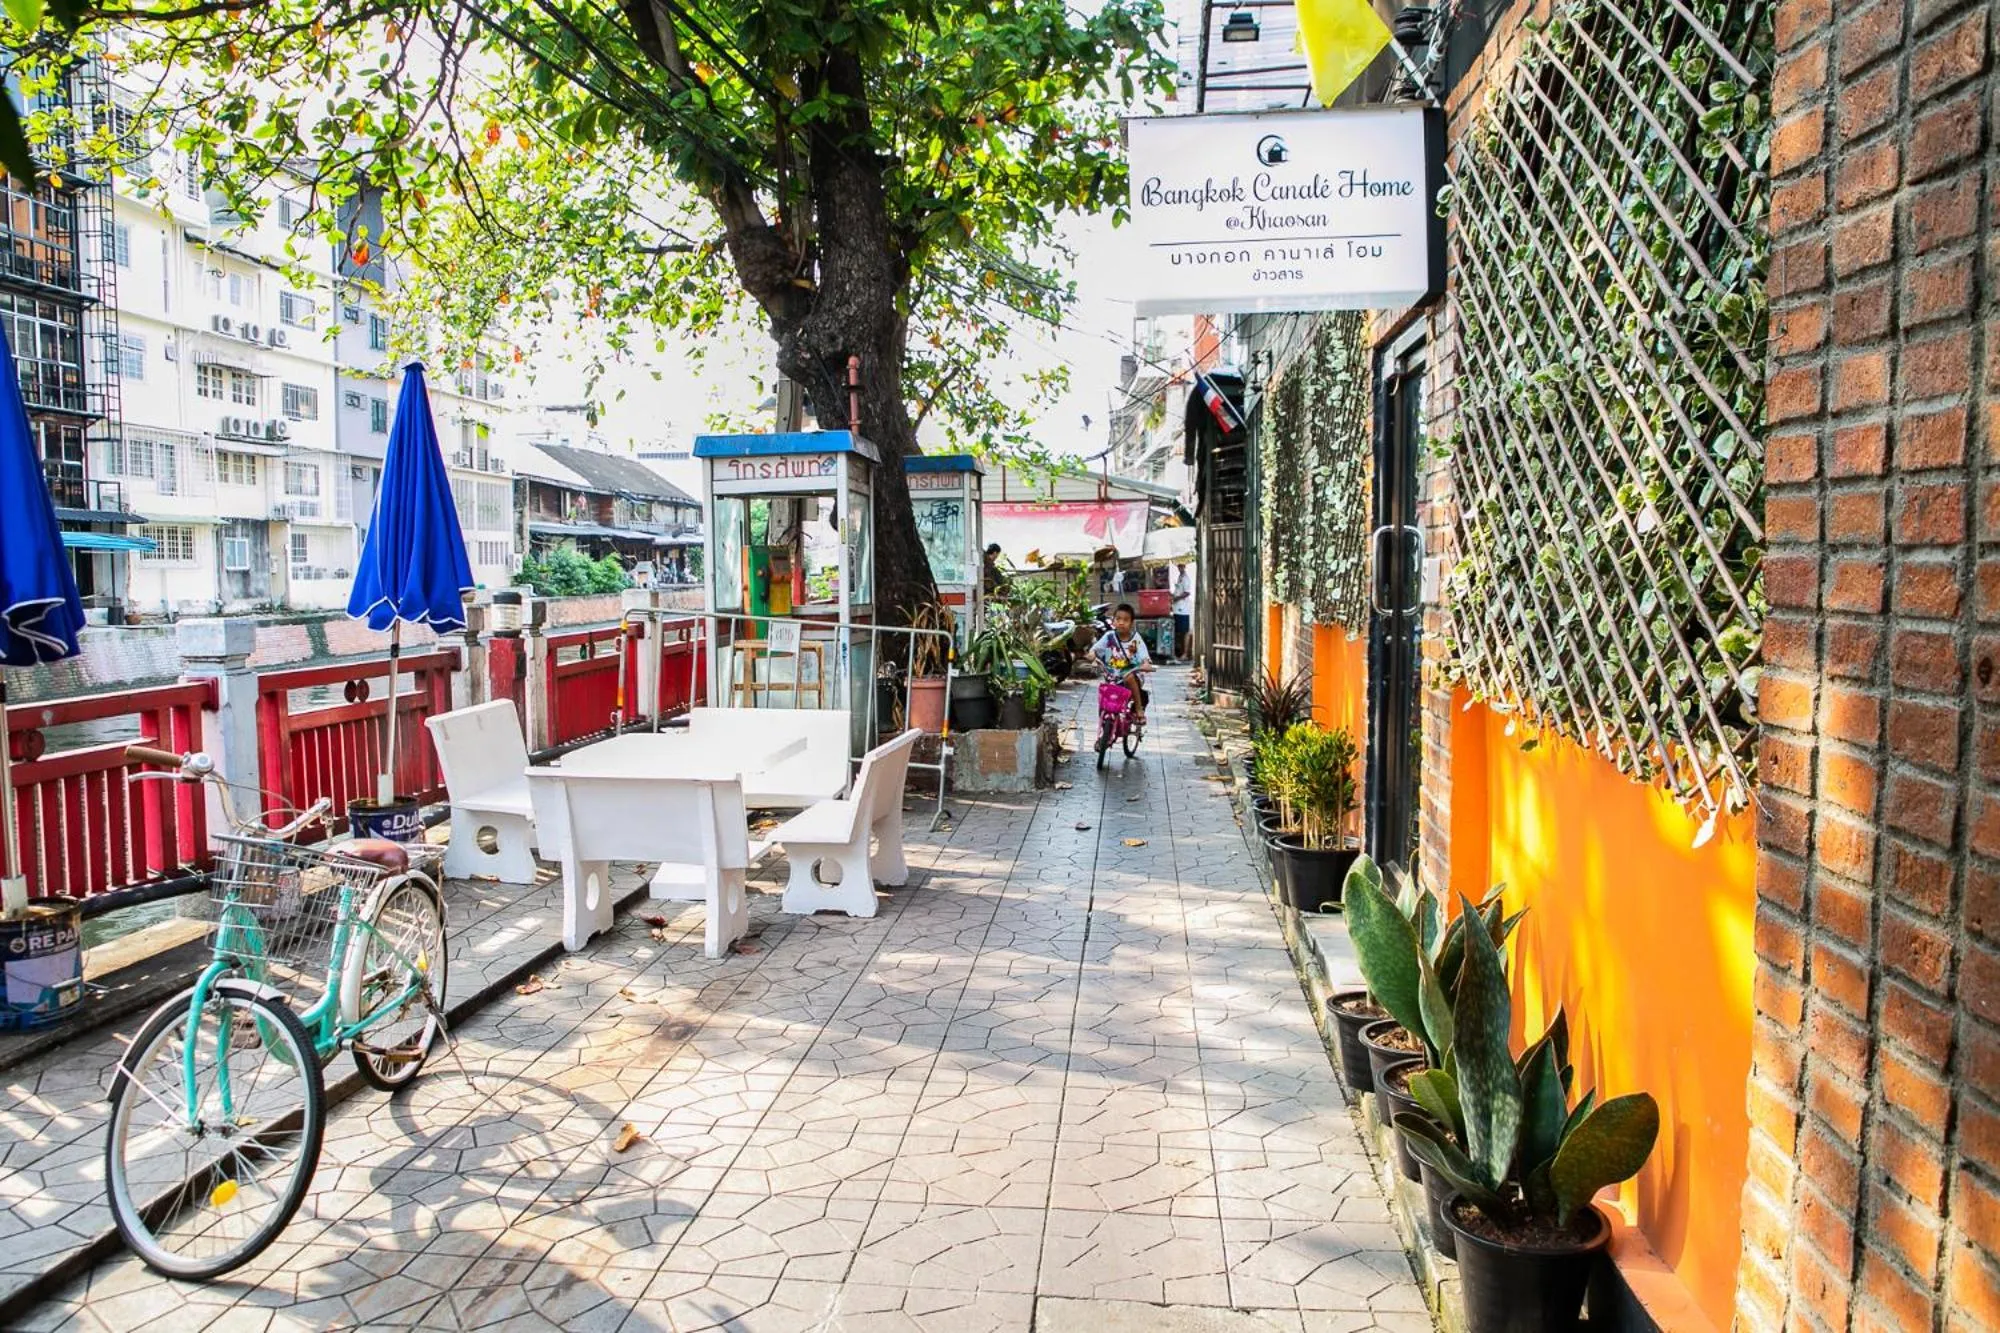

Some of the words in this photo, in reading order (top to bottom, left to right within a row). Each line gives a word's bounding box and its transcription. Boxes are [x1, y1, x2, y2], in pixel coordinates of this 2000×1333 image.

[1141, 176, 1246, 212] Bangkok
[1252, 172, 1332, 202] Canalé
[1338, 168, 1414, 199] Home
[1225, 205, 1328, 231] @Khaosan
[1171, 250, 1250, 265] บางกอก
[1347, 241, 1383, 258] โฮม
